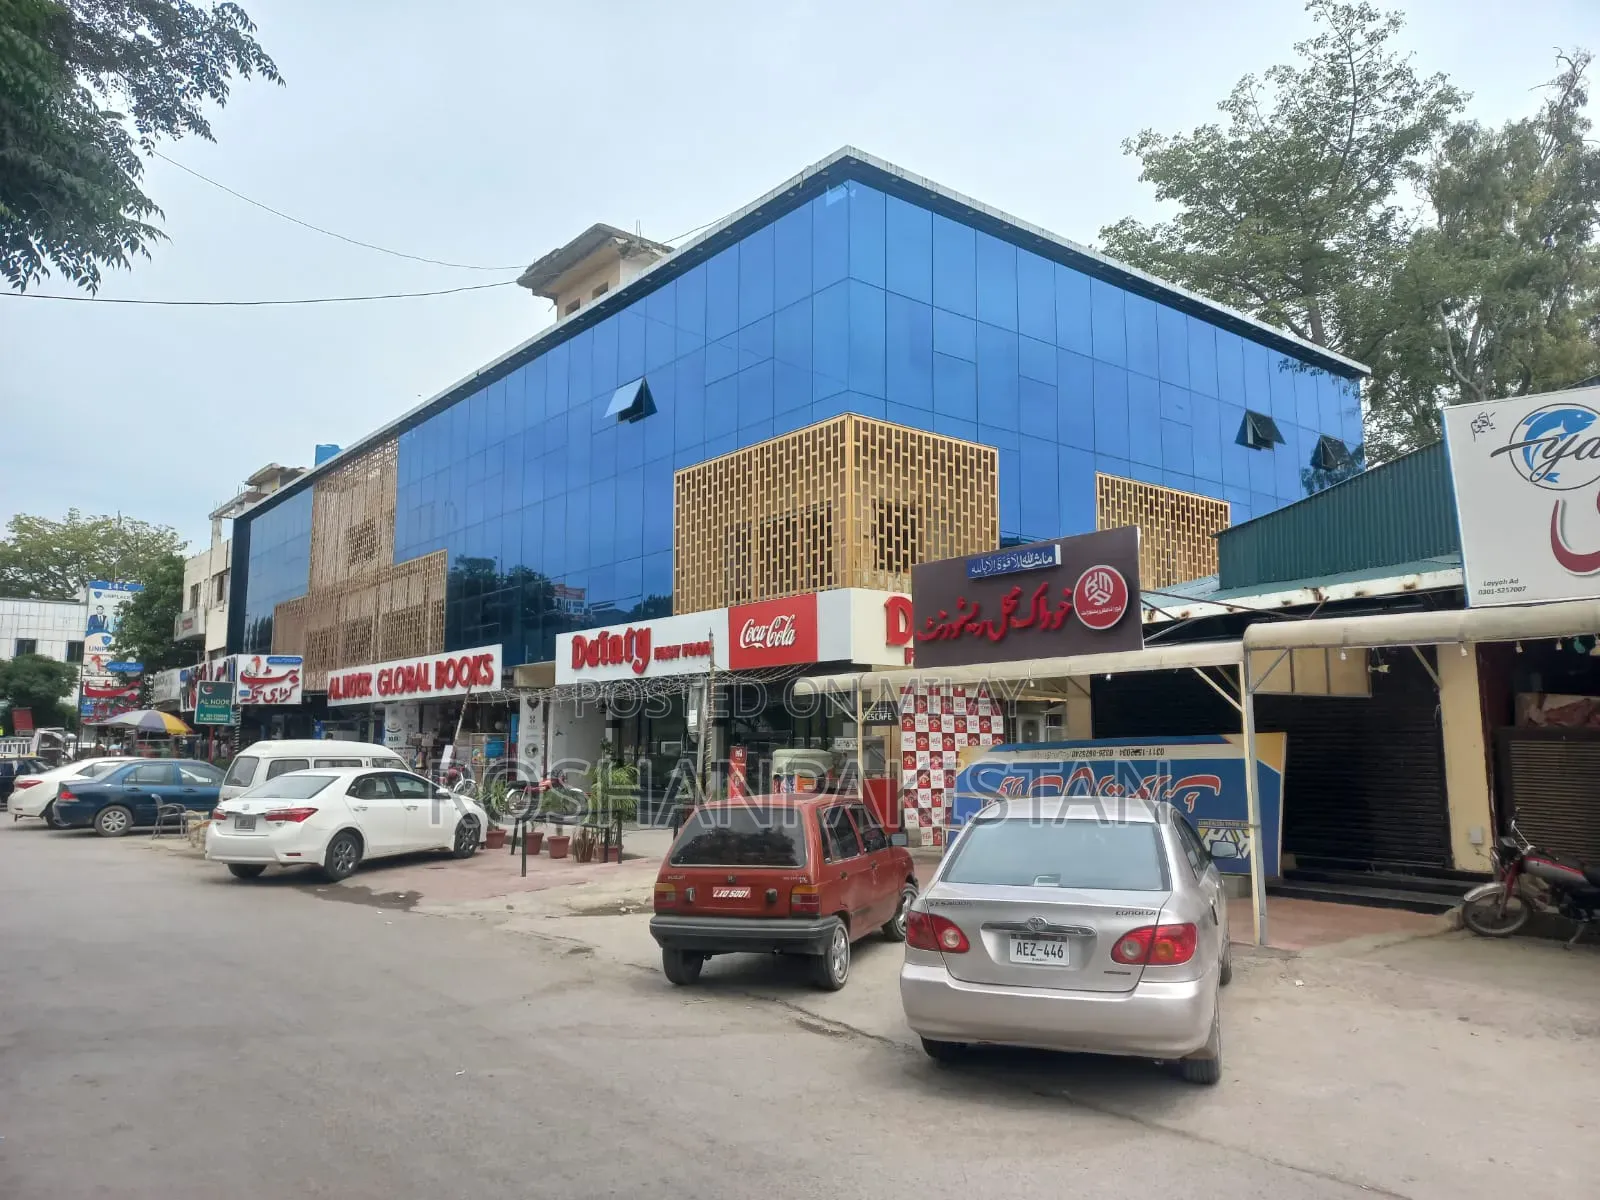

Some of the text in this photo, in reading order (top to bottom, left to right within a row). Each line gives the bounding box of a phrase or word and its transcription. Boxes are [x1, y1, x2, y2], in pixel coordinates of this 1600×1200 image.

[571, 626, 652, 676] Dainty
[739, 613, 796, 649] Coca-Cola
[376, 661, 432, 697] GLOBAL
[435, 652, 495, 690] BOOKS
[1016, 941, 1064, 959] AEZ-446
